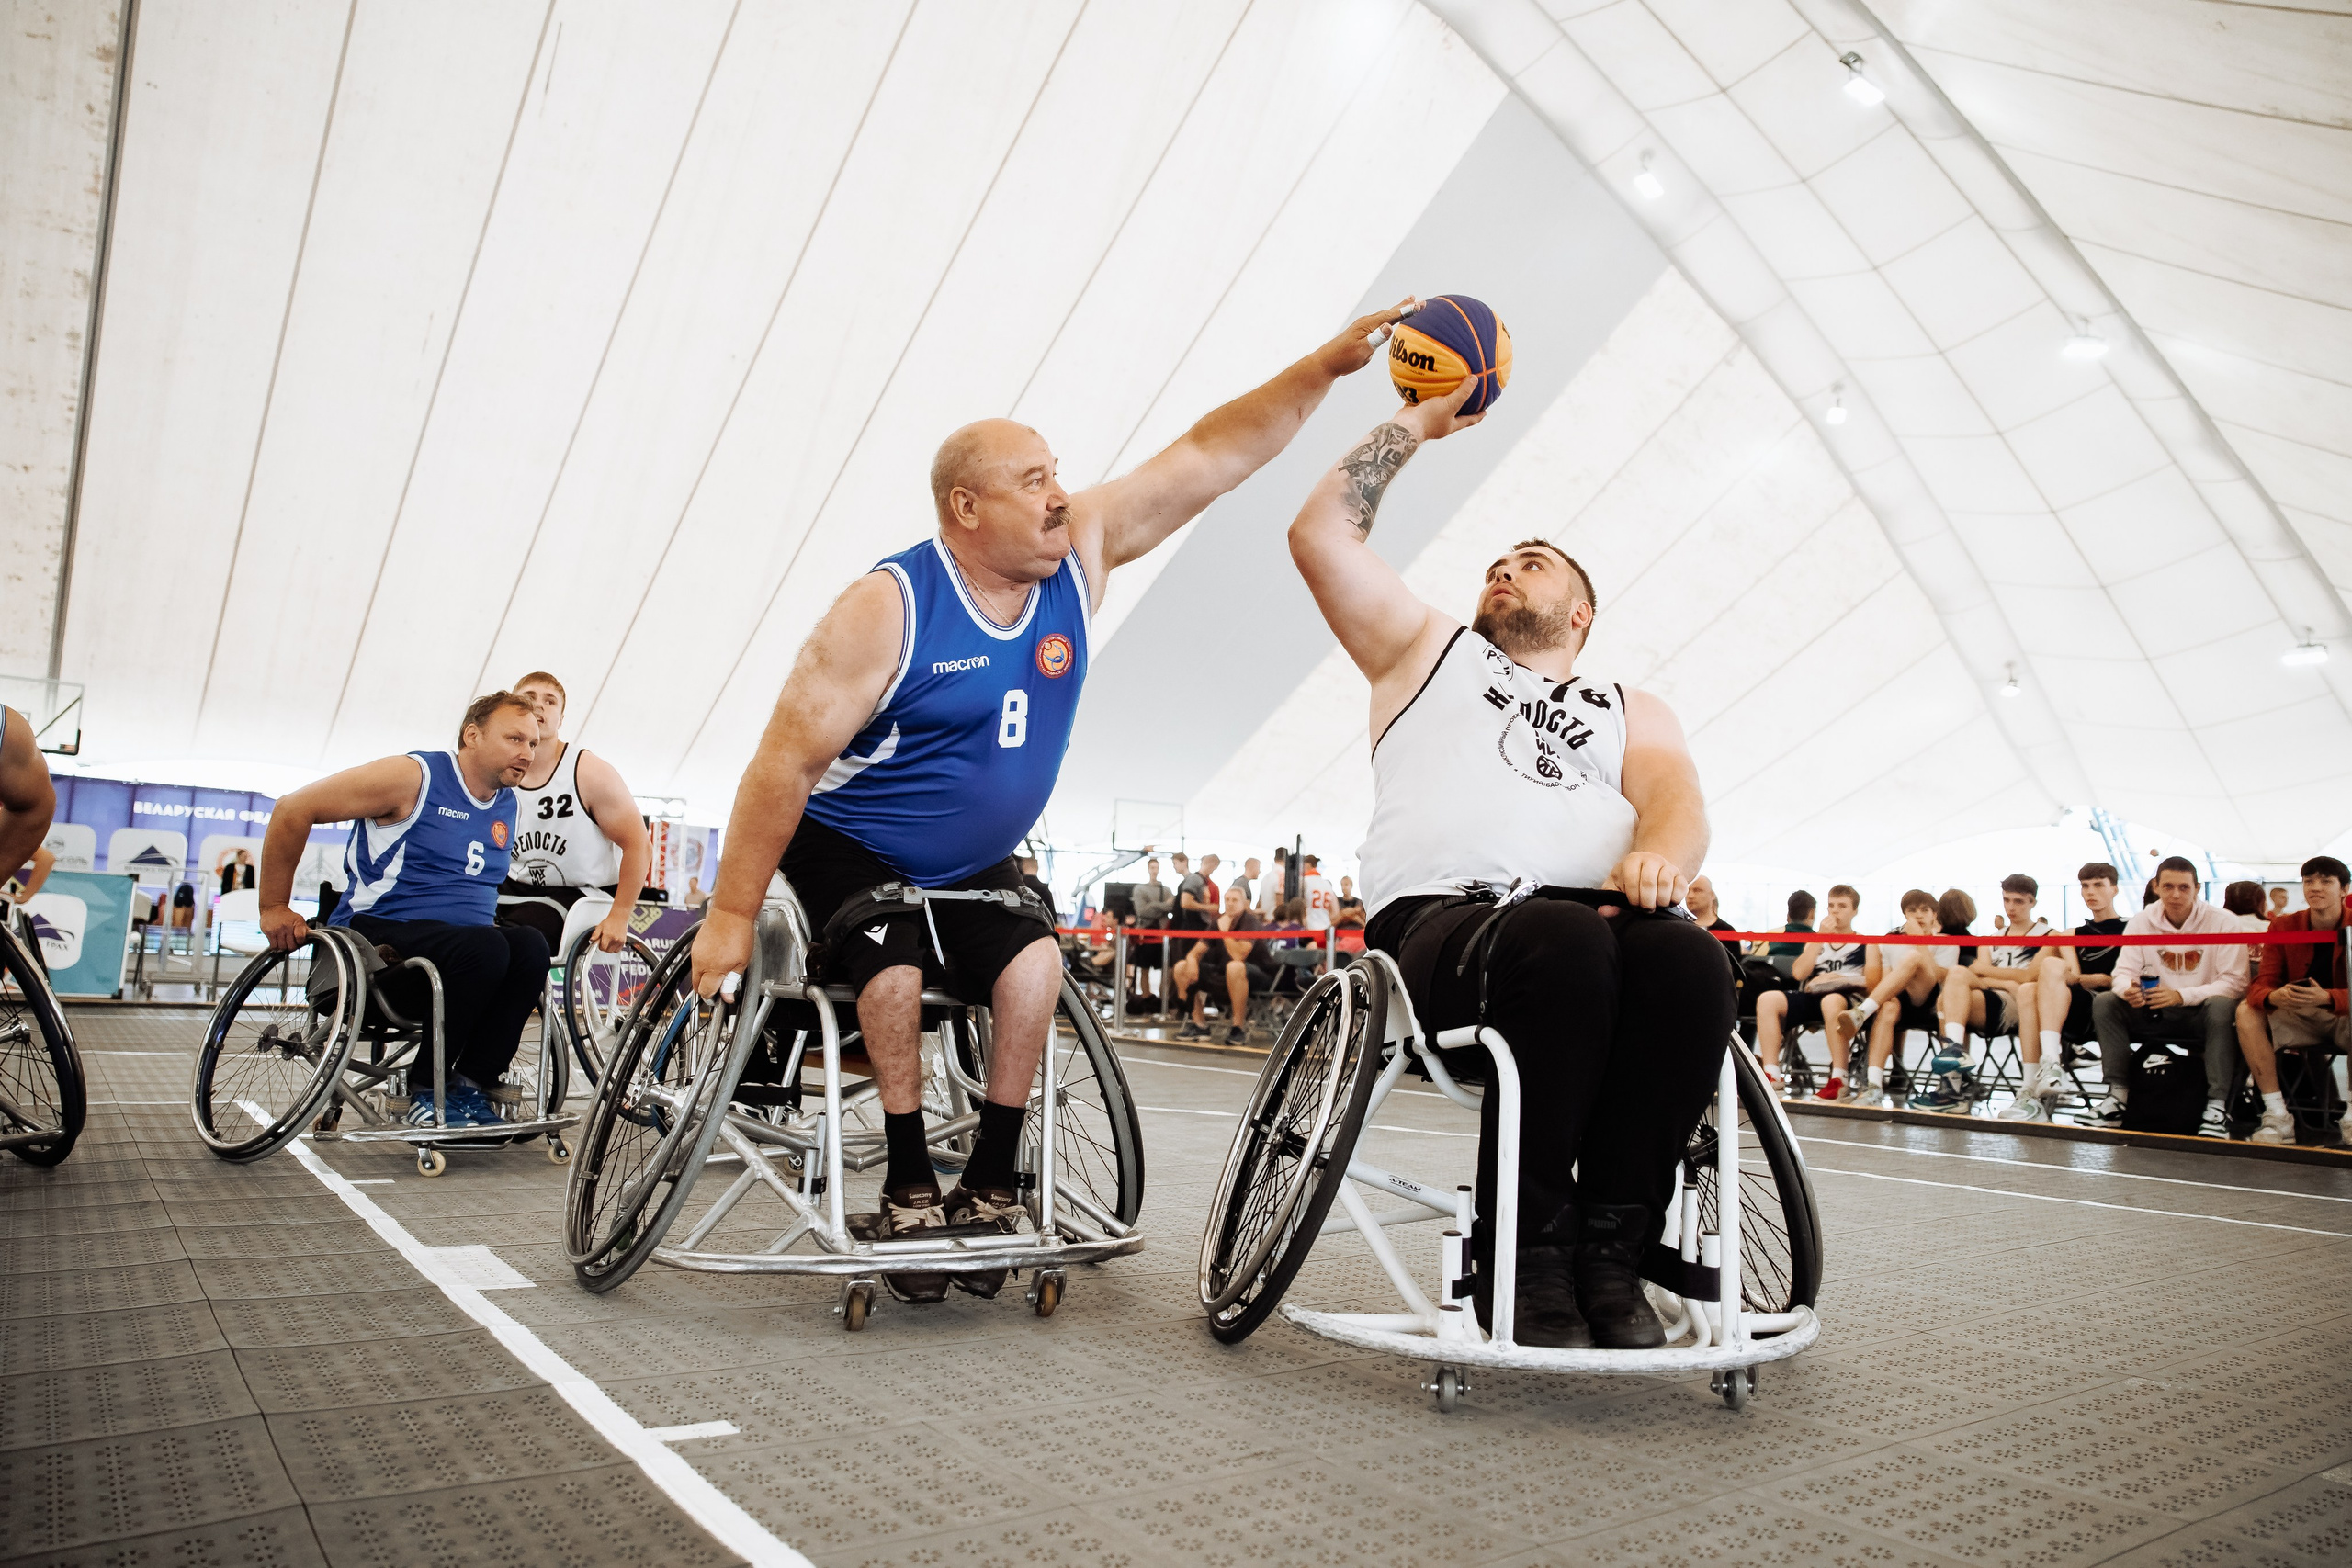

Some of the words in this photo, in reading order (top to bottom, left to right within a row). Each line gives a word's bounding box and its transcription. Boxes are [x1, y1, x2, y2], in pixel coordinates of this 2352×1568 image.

[933, 655, 990, 674] macron
[998, 689, 1029, 749] 8
[1482, 685, 1595, 750] КПОСТЬ
[133, 801, 236, 821] БЕЛАРУСКАЯ
[437, 807, 469, 821] macron
[537, 793, 574, 820] 32
[465, 840, 486, 876] 6
[1312, 890, 1331, 909] 26
